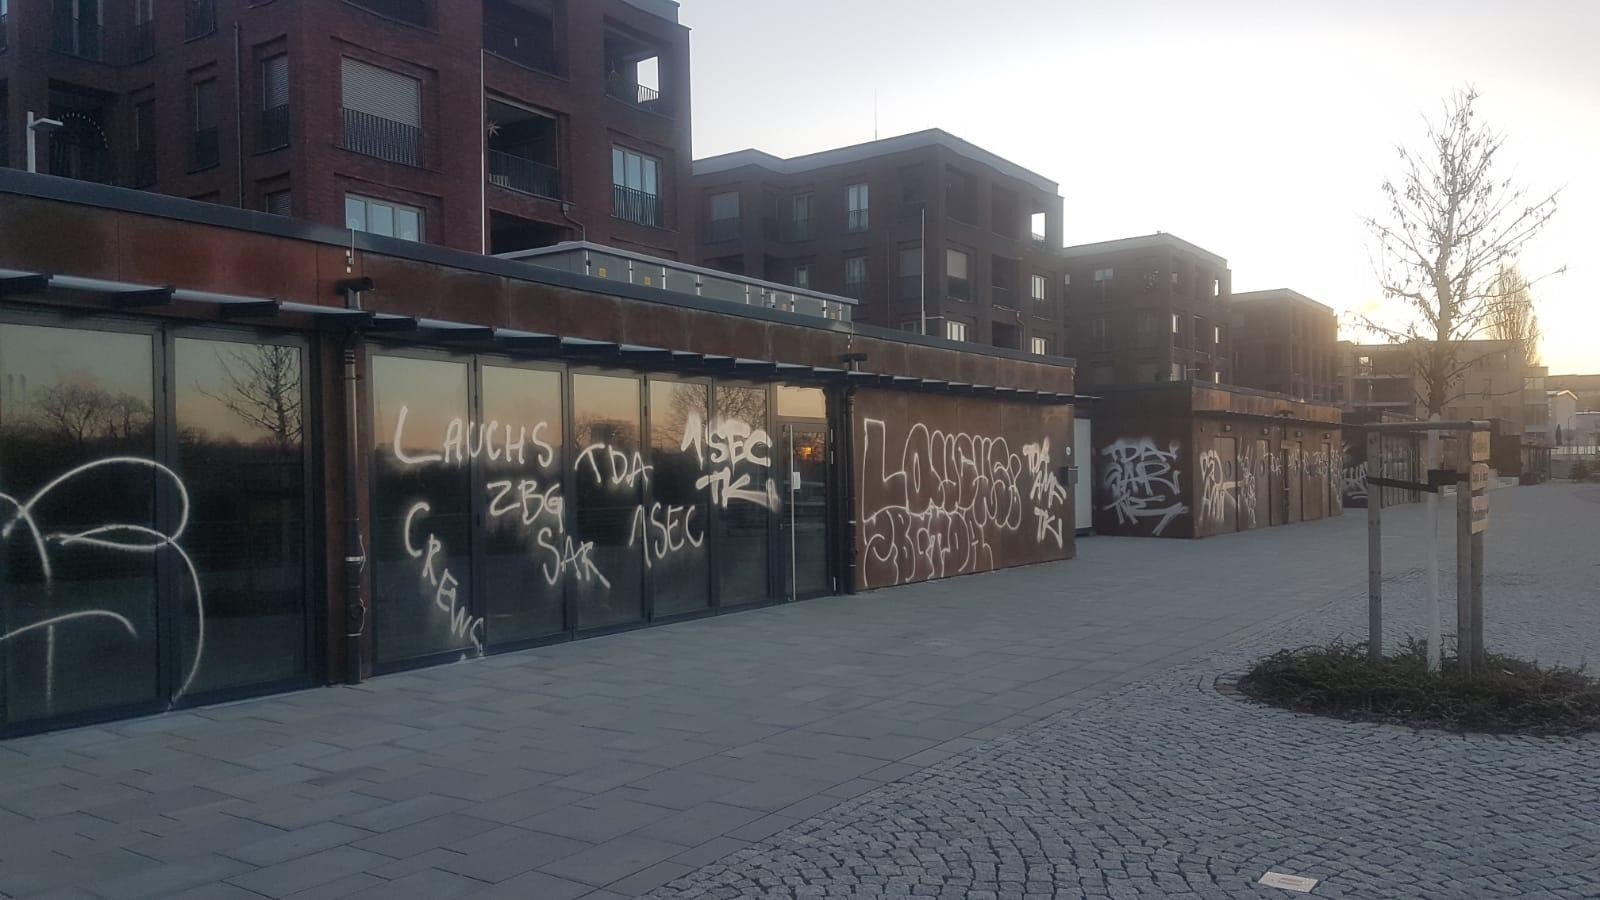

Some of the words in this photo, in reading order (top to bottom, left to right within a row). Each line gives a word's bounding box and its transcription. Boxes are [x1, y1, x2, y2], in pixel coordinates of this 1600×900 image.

[393, 405, 555, 470] LAUCHS
[574, 442, 655, 488] TDA
[487, 479, 565, 534] ZBG
[404, 501, 485, 659] CREWS
